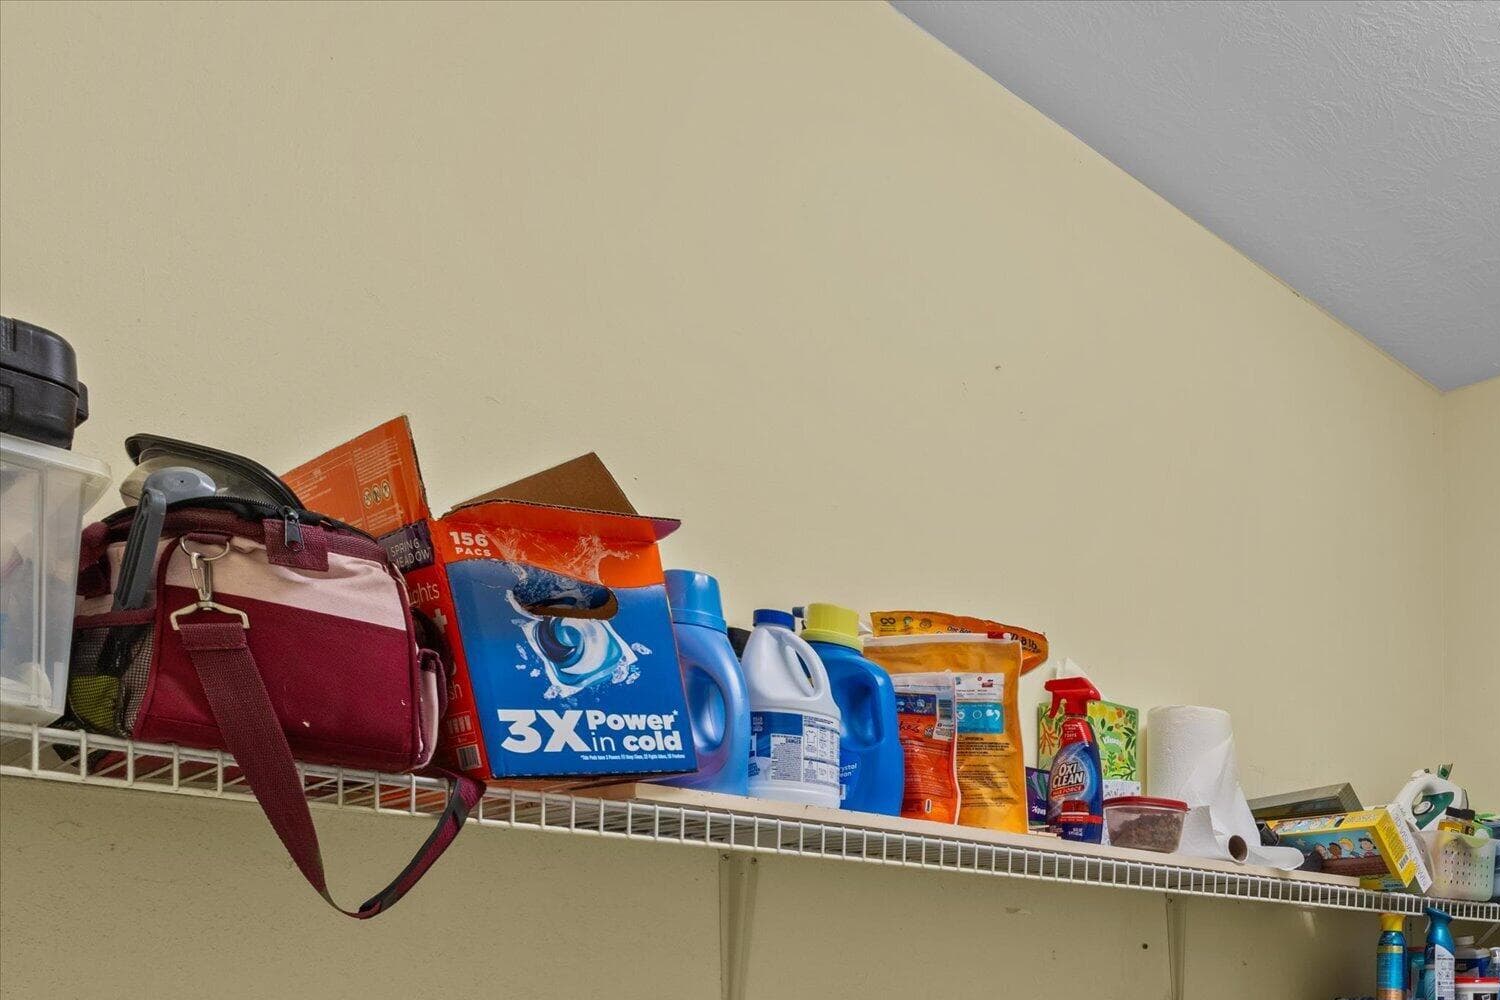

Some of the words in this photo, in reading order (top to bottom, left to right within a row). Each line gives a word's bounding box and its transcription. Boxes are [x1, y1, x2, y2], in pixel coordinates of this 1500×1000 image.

[390, 538, 420, 557] SPRING
[449, 531, 489, 547] 156
[455, 547, 492, 557] PACS
[409, 582, 440, 606] ights
[497, 709, 592, 754] 3X
[591, 732, 616, 752] in
[622, 730, 684, 752] cold
[1058, 762, 1078, 777] OXI
[1052, 771, 1085, 789] CLEAN
